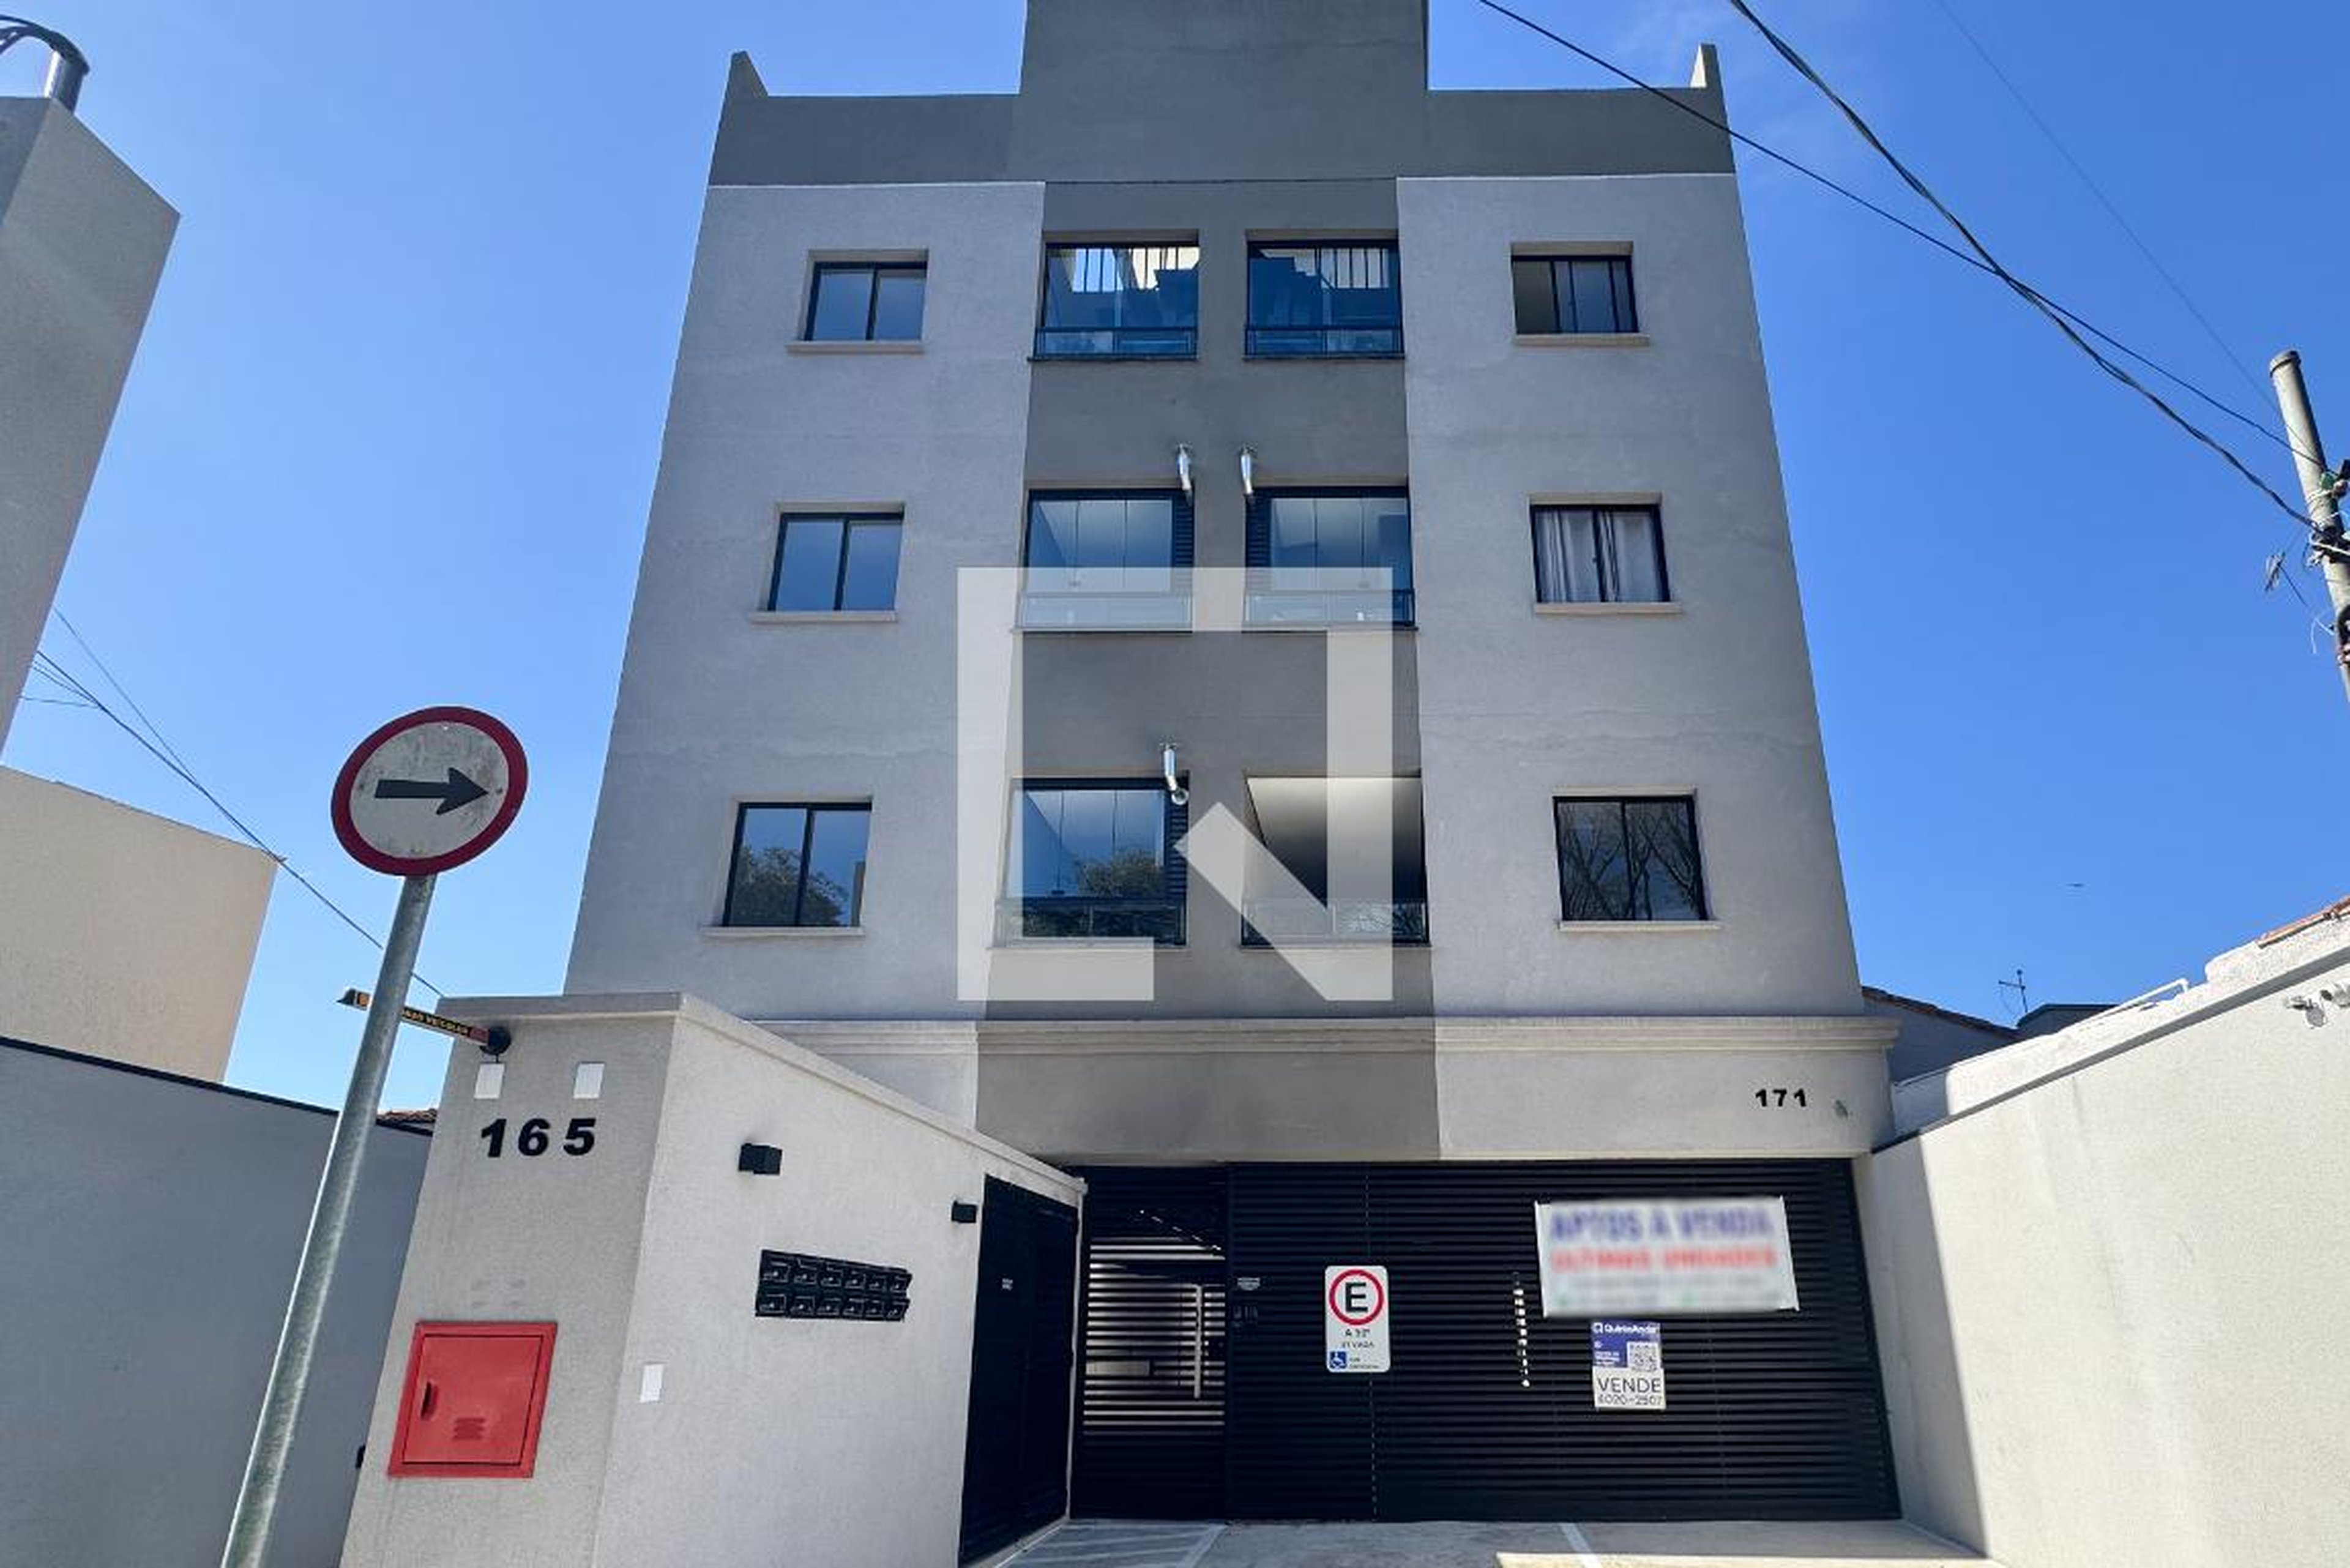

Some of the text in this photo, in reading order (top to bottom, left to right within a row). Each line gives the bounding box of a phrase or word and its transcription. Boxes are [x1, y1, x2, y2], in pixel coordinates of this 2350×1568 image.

[1756, 1088, 1807, 1107] 171
[481, 1118, 597, 1158] 165
[1345, 1282, 1368, 1312] E
[1597, 1378, 1661, 1393] VENDE
